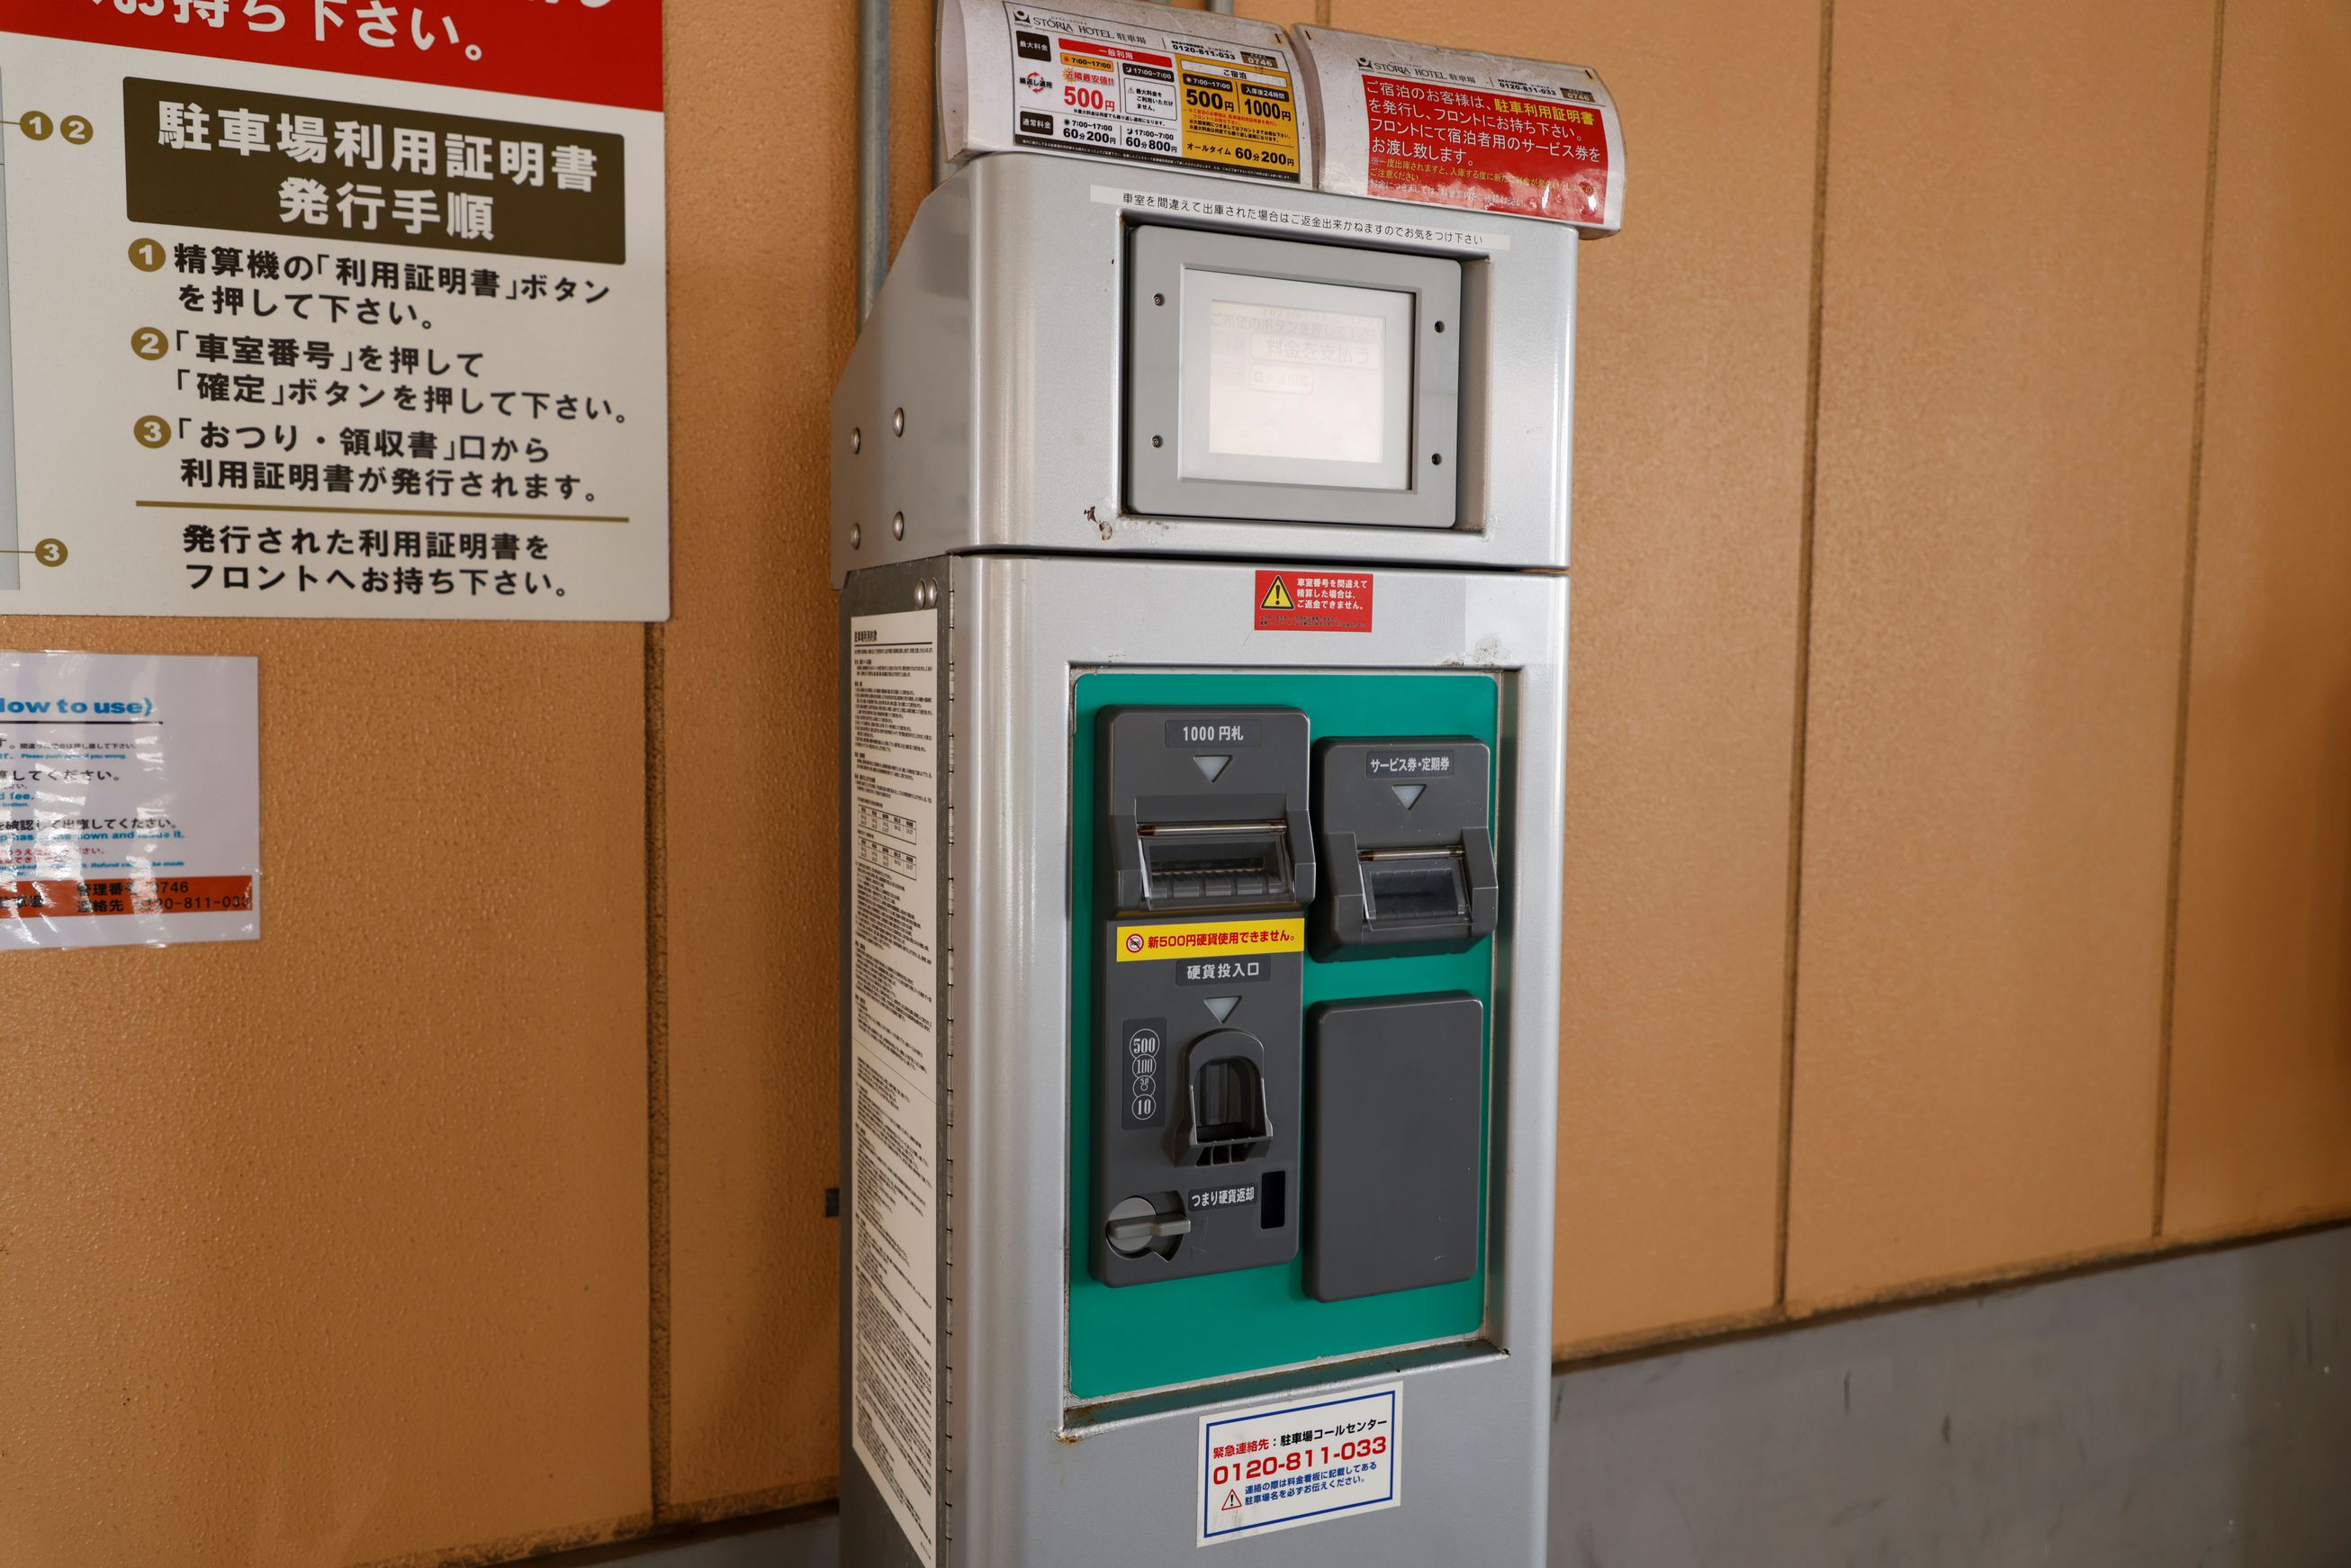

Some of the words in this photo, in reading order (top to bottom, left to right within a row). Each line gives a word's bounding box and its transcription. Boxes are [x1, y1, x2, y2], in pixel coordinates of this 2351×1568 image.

[1078, 24, 1115, 40] HOTEL
[1019, 40, 1049, 51] 最大料金
[1172, 43, 1236, 60] 0120-811-033
[1223, 68, 1248, 80] ご宿泊
[1414, 68, 1448, 80] HOTEL
[1064, 86, 1115, 113] 500円
[1499, 82, 1556, 96] 0120-811-033
[1185, 89, 1235, 113] 500円
[1244, 98, 1292, 122] 1000円
[1368, 99, 1583, 142] を発行し、フロントにお持ち下さい。
[158, 100, 598, 193] 駐車場利用証明書
[1186, 141, 1231, 156] オールタイム
[1370, 117, 1601, 164] フロントにて宿泊者用のサービス券を
[1372, 136, 1474, 167] お渡し致します。
[278, 176, 496, 241] 発行手順
[1122, 192, 1483, 246] 車室を間違えて出庫された場合はご返金出来かねますのでお気をつけ下さい
[174, 242, 610, 304] 精算機の「利用証明書」ボタン
[178, 284, 432, 330] を押して下さい。
[176, 329, 484, 378] 「車室番号」を押して
[176, 369, 627, 424] 「確定」ボタンを押して下さい。
[178, 417, 550, 464] 「おつり・領収書」口から
[180, 458, 595, 503] 利用証明書が発行されます。
[183, 524, 549, 562] 発行された利用証明書を
[185, 563, 567, 598] フロントへお持ち下さい。
[1296, 577, 1368, 590] 車室番号を間違えて
[1296, 588, 1356, 599] 精算した場合は、
[1296, 599, 1364, 610] ご返金できません。
[0, 698, 51, 713] ow
[57, 698, 88, 713] to
[1182, 725, 1215, 742] 1000
[1218, 725, 1244, 742] 円札
[1369, 755, 1450, 774] サービス券・定期券
[113, 831, 134, 839] and
[1147, 928, 1296, 950] 新500円硬貨使用できません。
[1186, 961, 1260, 980] 硬貨投入口
[1132, 1038, 1156, 1055] 500
[1135, 1058, 1154, 1075] 100
[1135, 1098, 1151, 1116] 10
[1190, 1185, 1255, 1208] つまり硬貨返却
[1212, 1435, 1387, 1485] 0120-811-033
[1244, 1461, 1377, 1495] 連絡の際は料金看板に記載してある
[1244, 1475, 1365, 1506] 駐車場名を必ずお伝えください。
